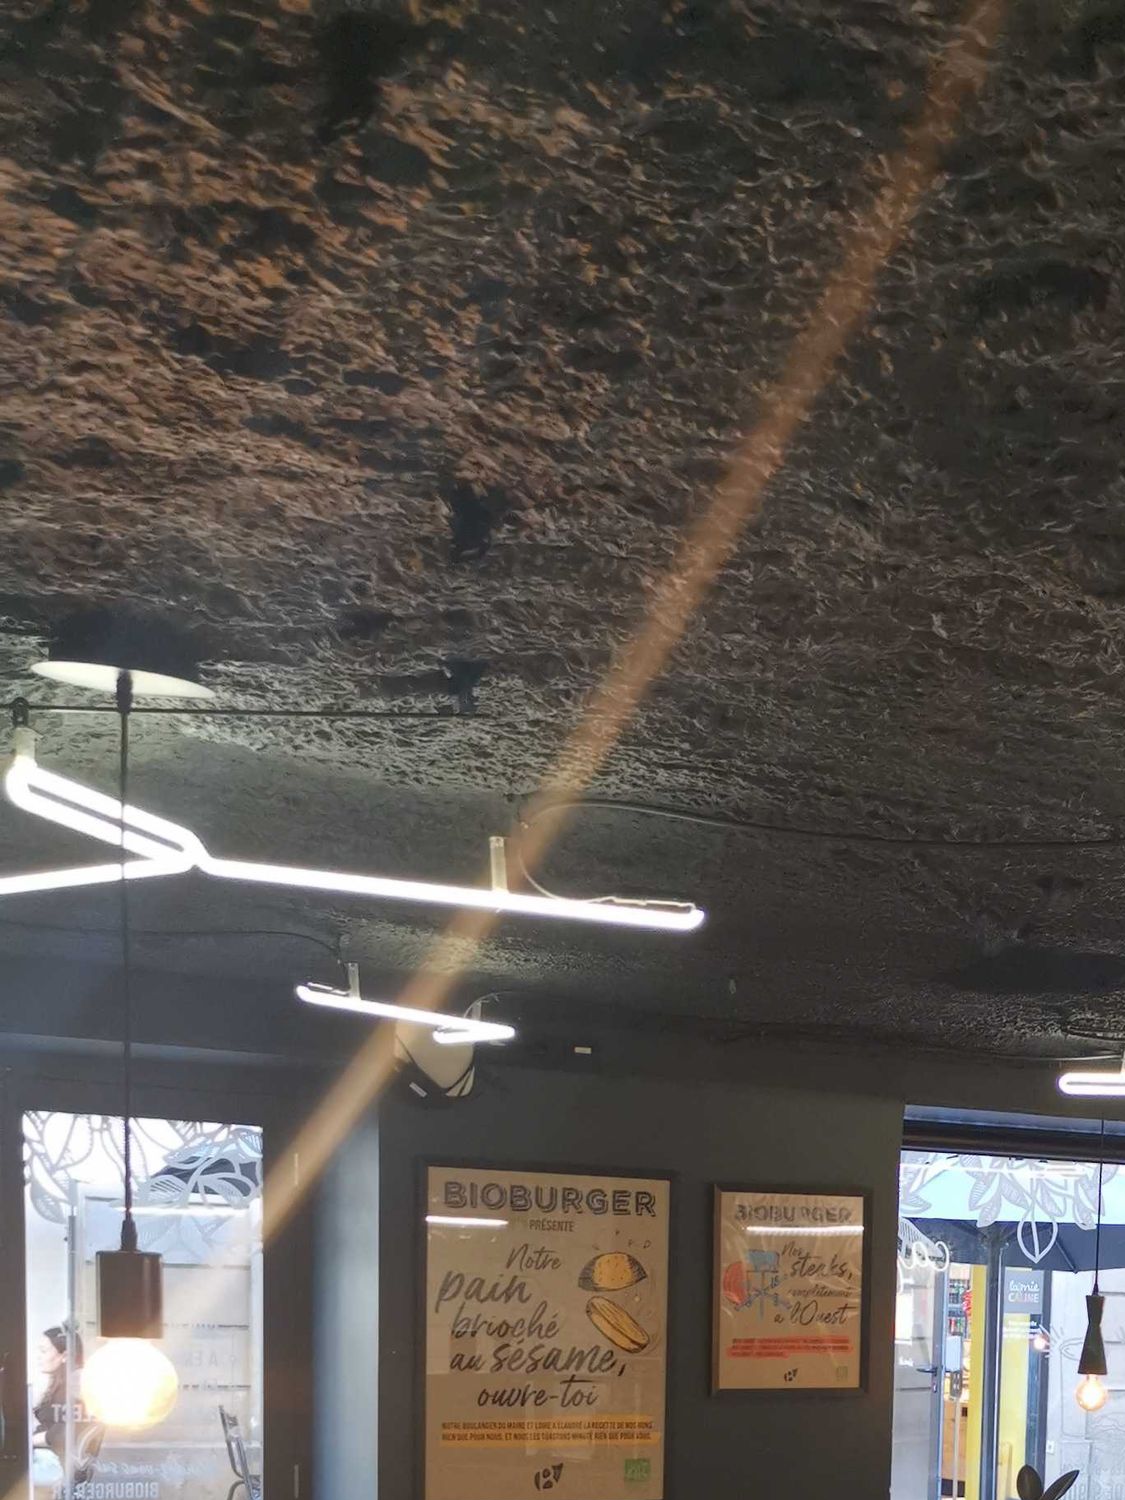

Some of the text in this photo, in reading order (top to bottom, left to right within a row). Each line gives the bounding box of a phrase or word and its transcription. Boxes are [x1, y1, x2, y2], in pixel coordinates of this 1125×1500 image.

[444, 1181, 657, 1217] BIOBURGER
[529, 1218, 576, 1233] PRÉSENTE
[506, 1242, 562, 1271] Notre
[435, 1271, 533, 1314] pain
[450, 1300, 561, 1340] brioché
[450, 1338, 627, 1377] au sésame,
[477, 1374, 602, 1407] ouvre-toi
